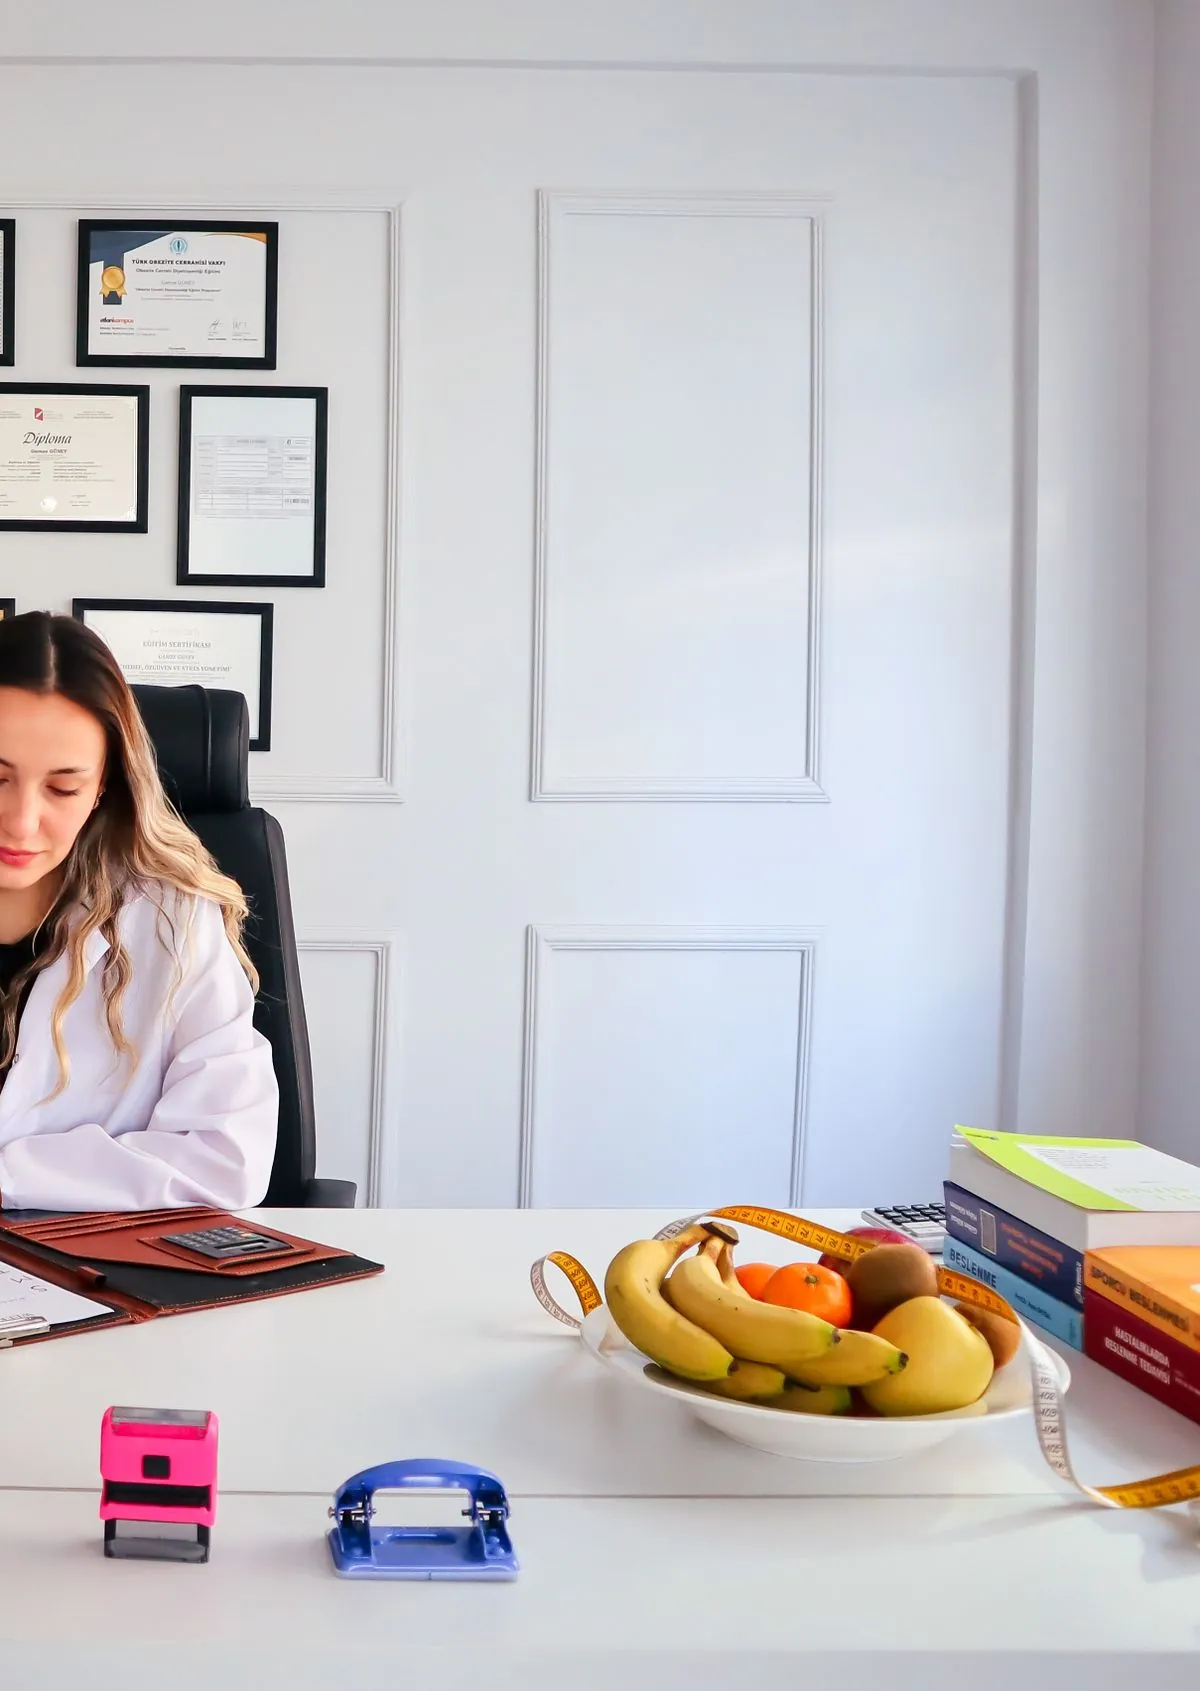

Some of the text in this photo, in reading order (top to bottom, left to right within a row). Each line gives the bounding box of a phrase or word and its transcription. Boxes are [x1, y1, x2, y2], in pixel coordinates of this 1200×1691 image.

[22, 432, 72, 447] Diploma
[142, 640, 211, 649] EĞİTİM SERTİFİKASI
[949, 1247, 998, 1289] BESLENME
[1104, 1336, 1138, 1366] BESLENME
